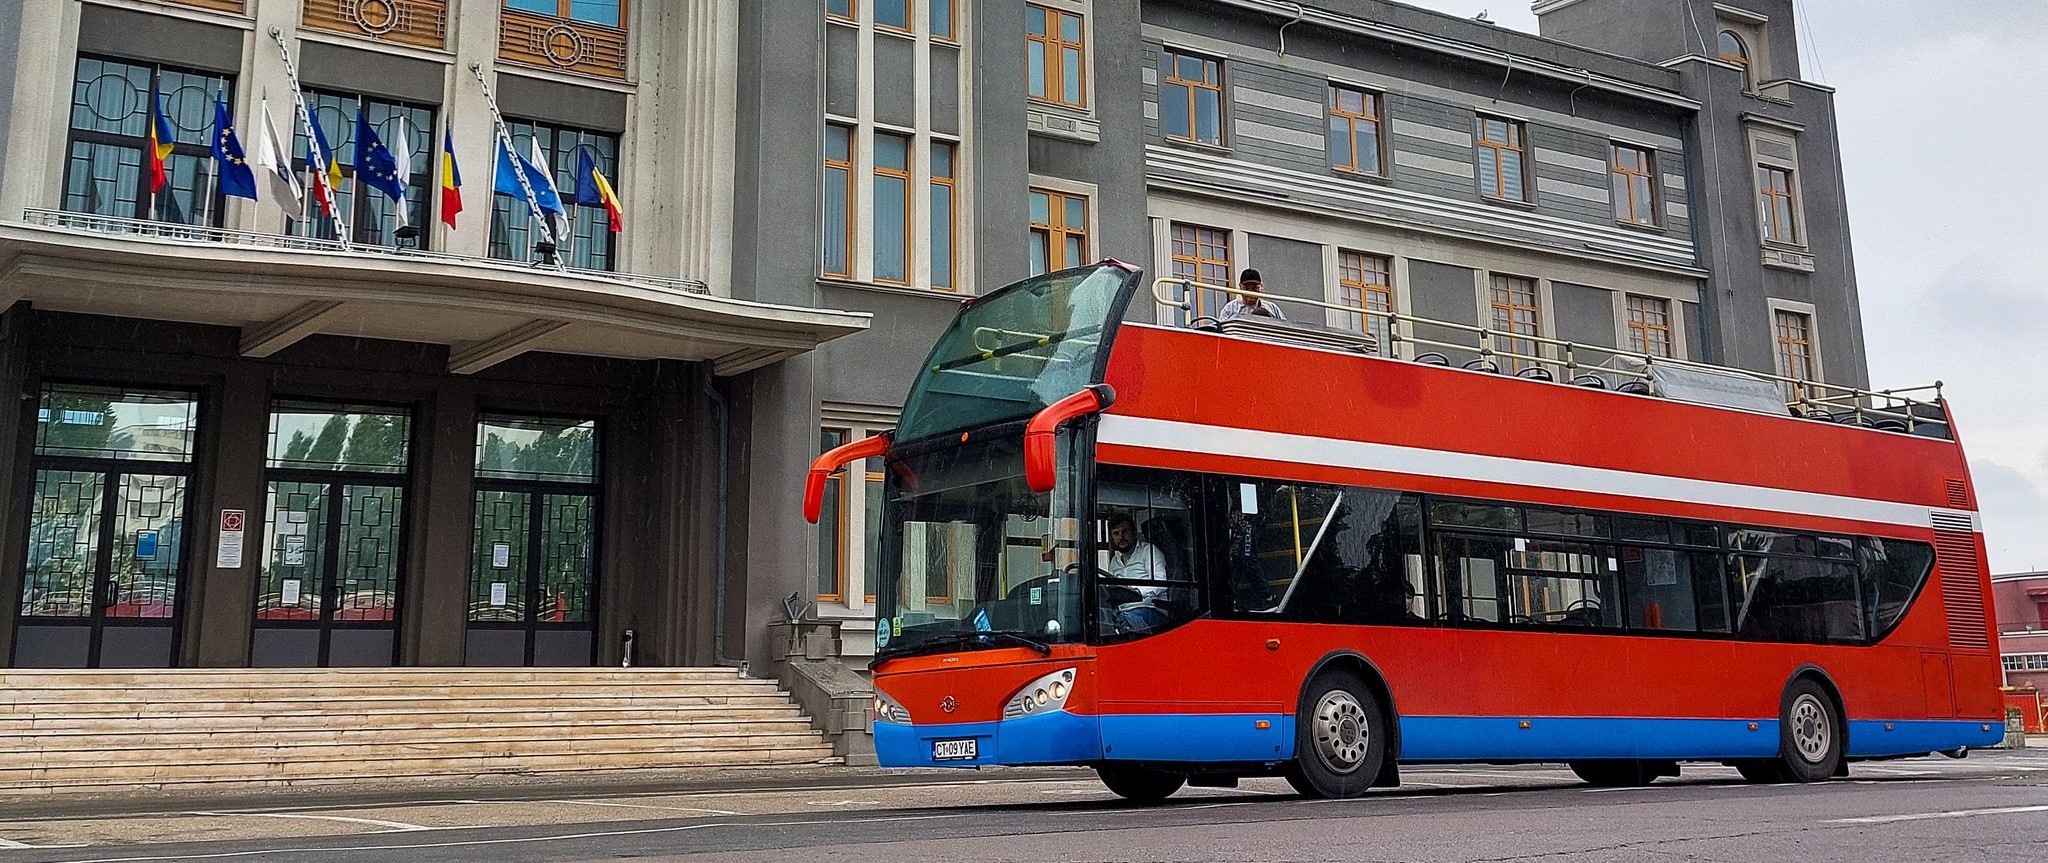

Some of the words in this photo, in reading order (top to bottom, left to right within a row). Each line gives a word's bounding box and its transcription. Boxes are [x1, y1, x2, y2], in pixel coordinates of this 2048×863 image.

[937, 743, 946, 756] CT
[949, 742, 958, 755] 09
[959, 741, 974, 755] YAE
